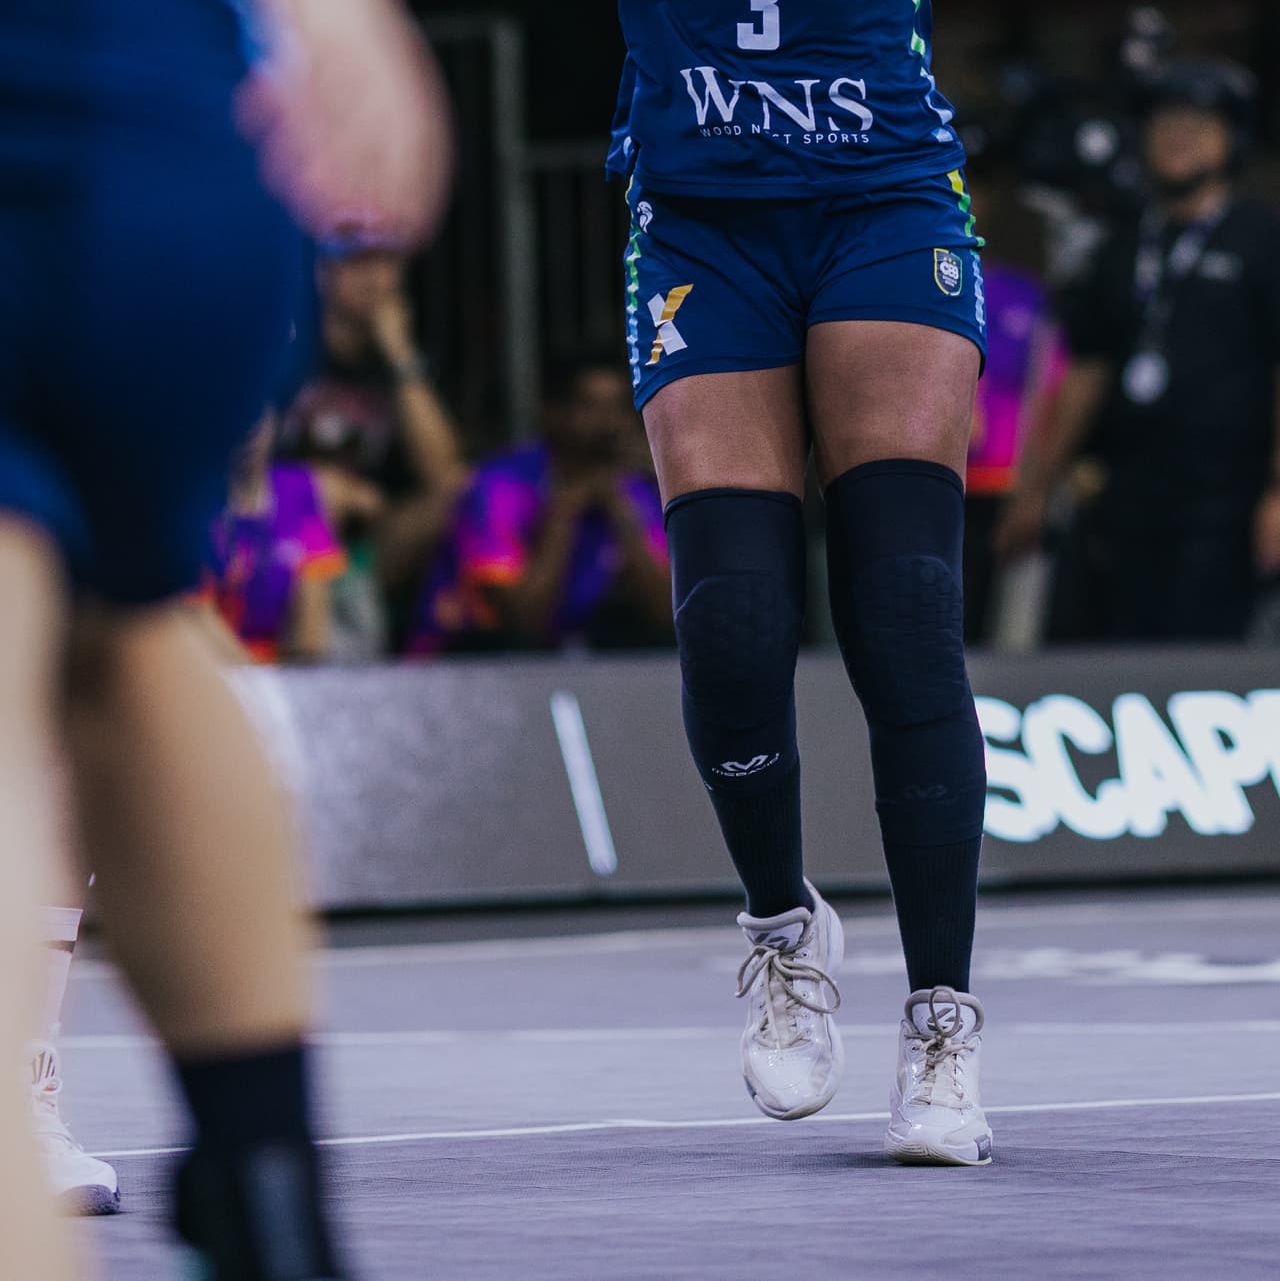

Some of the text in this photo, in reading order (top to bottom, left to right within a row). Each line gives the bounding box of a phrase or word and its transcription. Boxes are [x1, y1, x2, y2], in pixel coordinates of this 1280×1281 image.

[679, 66, 874, 132] WNS
[700, 124, 742, 137] WOOD
[803, 132, 870, 145] SPORTS
